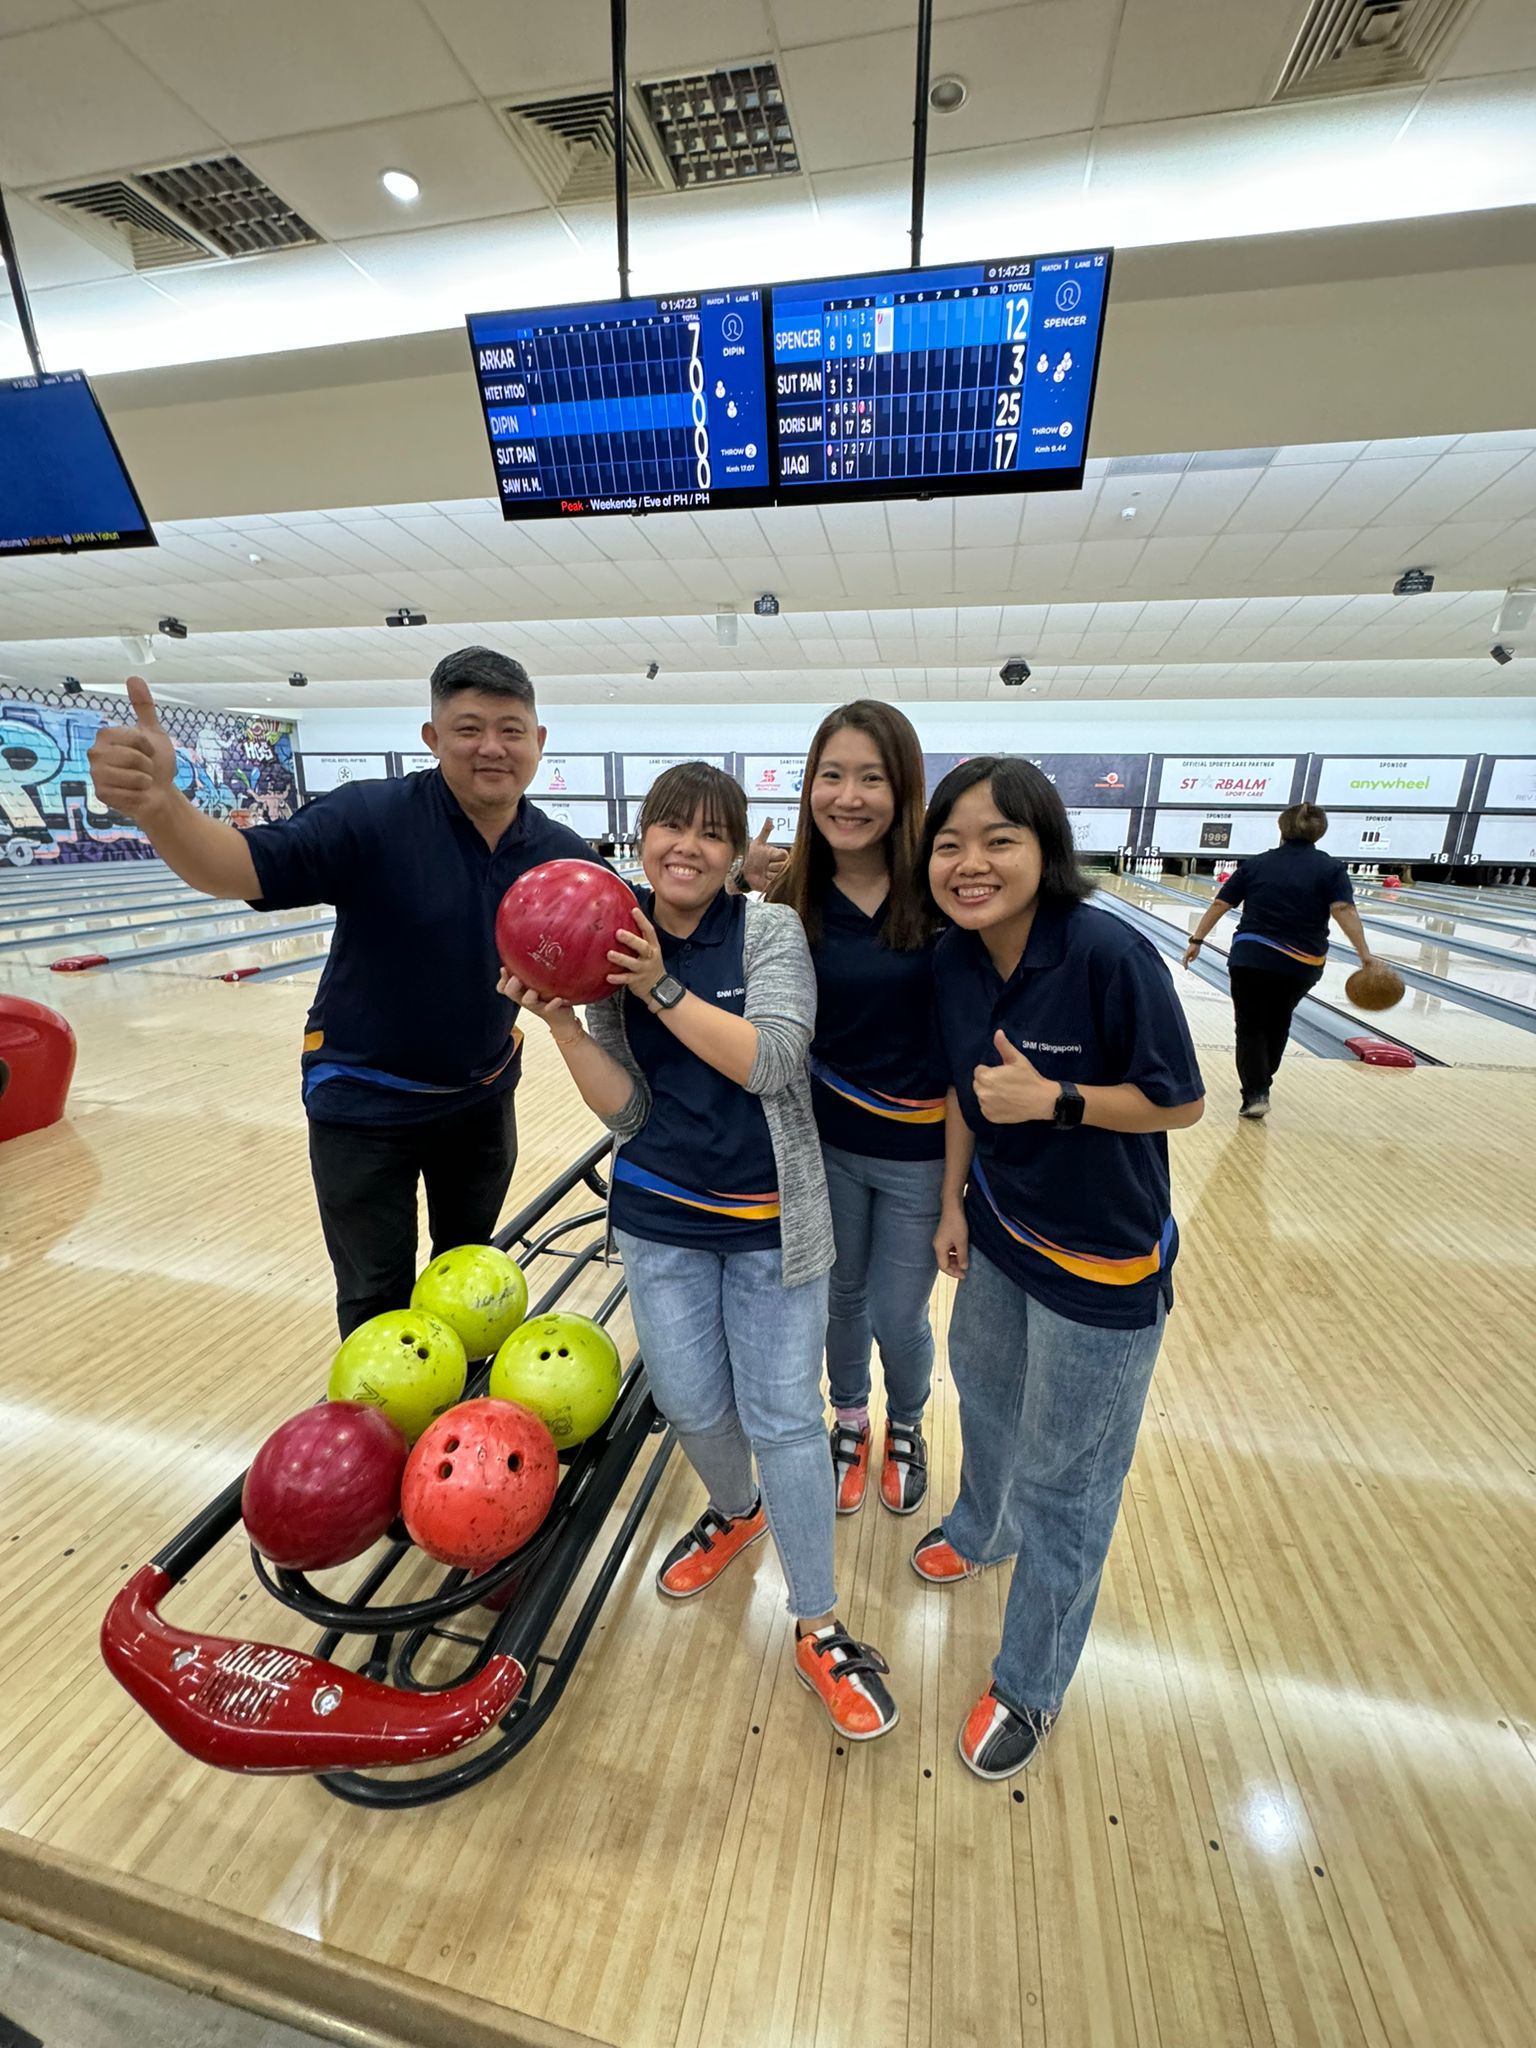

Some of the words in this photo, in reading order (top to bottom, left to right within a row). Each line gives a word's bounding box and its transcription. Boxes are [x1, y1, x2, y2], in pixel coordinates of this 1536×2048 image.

[1064, 260, 1069, 270] 1
[1075, 261, 1091, 269] LANE
[1094, 256, 1104, 267] 12
[998, 264, 1030, 278] 1:47:23
[669, 298, 697, 310] 1:47:23
[726, 294, 730, 303] 1
[752, 291, 759, 301] 11
[830, 302, 834, 310] 1
[847, 300, 852, 308] 2
[865, 298, 870, 306] 3
[900, 295, 905, 303] 5
[918, 293, 923, 301] 6
[936, 291, 941, 299] 7
[954, 289, 959, 298] 8
[972, 288, 978, 296] 9
[989, 285, 998, 294] 10
[1007, 283, 1032, 293] TOTAL
[682, 314, 700, 322] TOTAL
[826, 316, 830, 328] 7
[860, 313, 865, 325] 3
[1006, 298, 1029, 340] 12
[1044, 316, 1087, 328] SPENCER
[688, 322, 700, 358] 7
[776, 329, 821, 350] SPENCER
[830, 336, 835, 351] 8
[847, 334, 853, 349] 9
[862, 332, 871, 348] 12
[723, 346, 744, 356] DIPIN
[480, 348, 516, 370] ARKAR
[527, 355, 532, 367] 7
[826, 361, 831, 373] 3
[860, 358, 865, 370] 3
[1009, 344, 1025, 386] 3
[689, 357, 704, 394] 0
[777, 374, 798, 394] SUT
[800, 372, 821, 392] PAN
[484, 385, 502, 400] HTET
[504, 384, 525, 399] HTOO
[830, 379, 836, 394] 3
[847, 378, 853, 393] 3
[692, 392, 706, 427] 0
[835, 403, 840, 415] 8
[843, 402, 848, 414] 6
[852, 402, 856, 413] 3
[996, 392, 1021, 426] 25
[490, 415, 519, 435] DIPIN
[780, 416, 806, 434] DORIS
[807, 416, 822, 431] LIM
[830, 421, 836, 436] 8
[846, 420, 854, 434] 17
[861, 419, 871, 434] 25
[1032, 427, 1058, 435] THROW
[694, 426, 708, 459] 0
[844, 444, 848, 454] 7
[852, 443, 856, 454] 2
[497, 447, 514, 465] SUT
[516, 446, 536, 463] PAN
[721, 448, 744, 456] THROW
[995, 432, 1018, 470] 17
[781, 455, 809, 475] JIAQI
[831, 461, 837, 476] 8
[846, 460, 854, 474] 17
[697, 458, 710, 489] 0
[502, 478, 520, 494] SAW
[522, 478, 531, 492] H.
[532, 477, 542, 492] M.
[561, 501, 584, 512] Peak
[590, 498, 637, 510] Weekends
[644, 496, 661, 508] Eve
[663, 495, 671, 507] of
[674, 494, 688, 506] PH
[695, 493, 709, 505] PH
[1350, 775, 1430, 790] anywheel
[608, 833, 615, 842] 6
[622, 833, 628, 842] 7
[1203, 833, 1228, 842] 1989
[1119, 846, 1132, 856] 14
[1144, 847, 1159, 857] 15
[1433, 853, 1449, 863] 18
[1463, 854, 1479, 864] 19
[716, 990, 732, 998] SNM
[1022, 1040, 1037, 1050] SNM
[1038, 1042, 1082, 1054] (Singapore)
